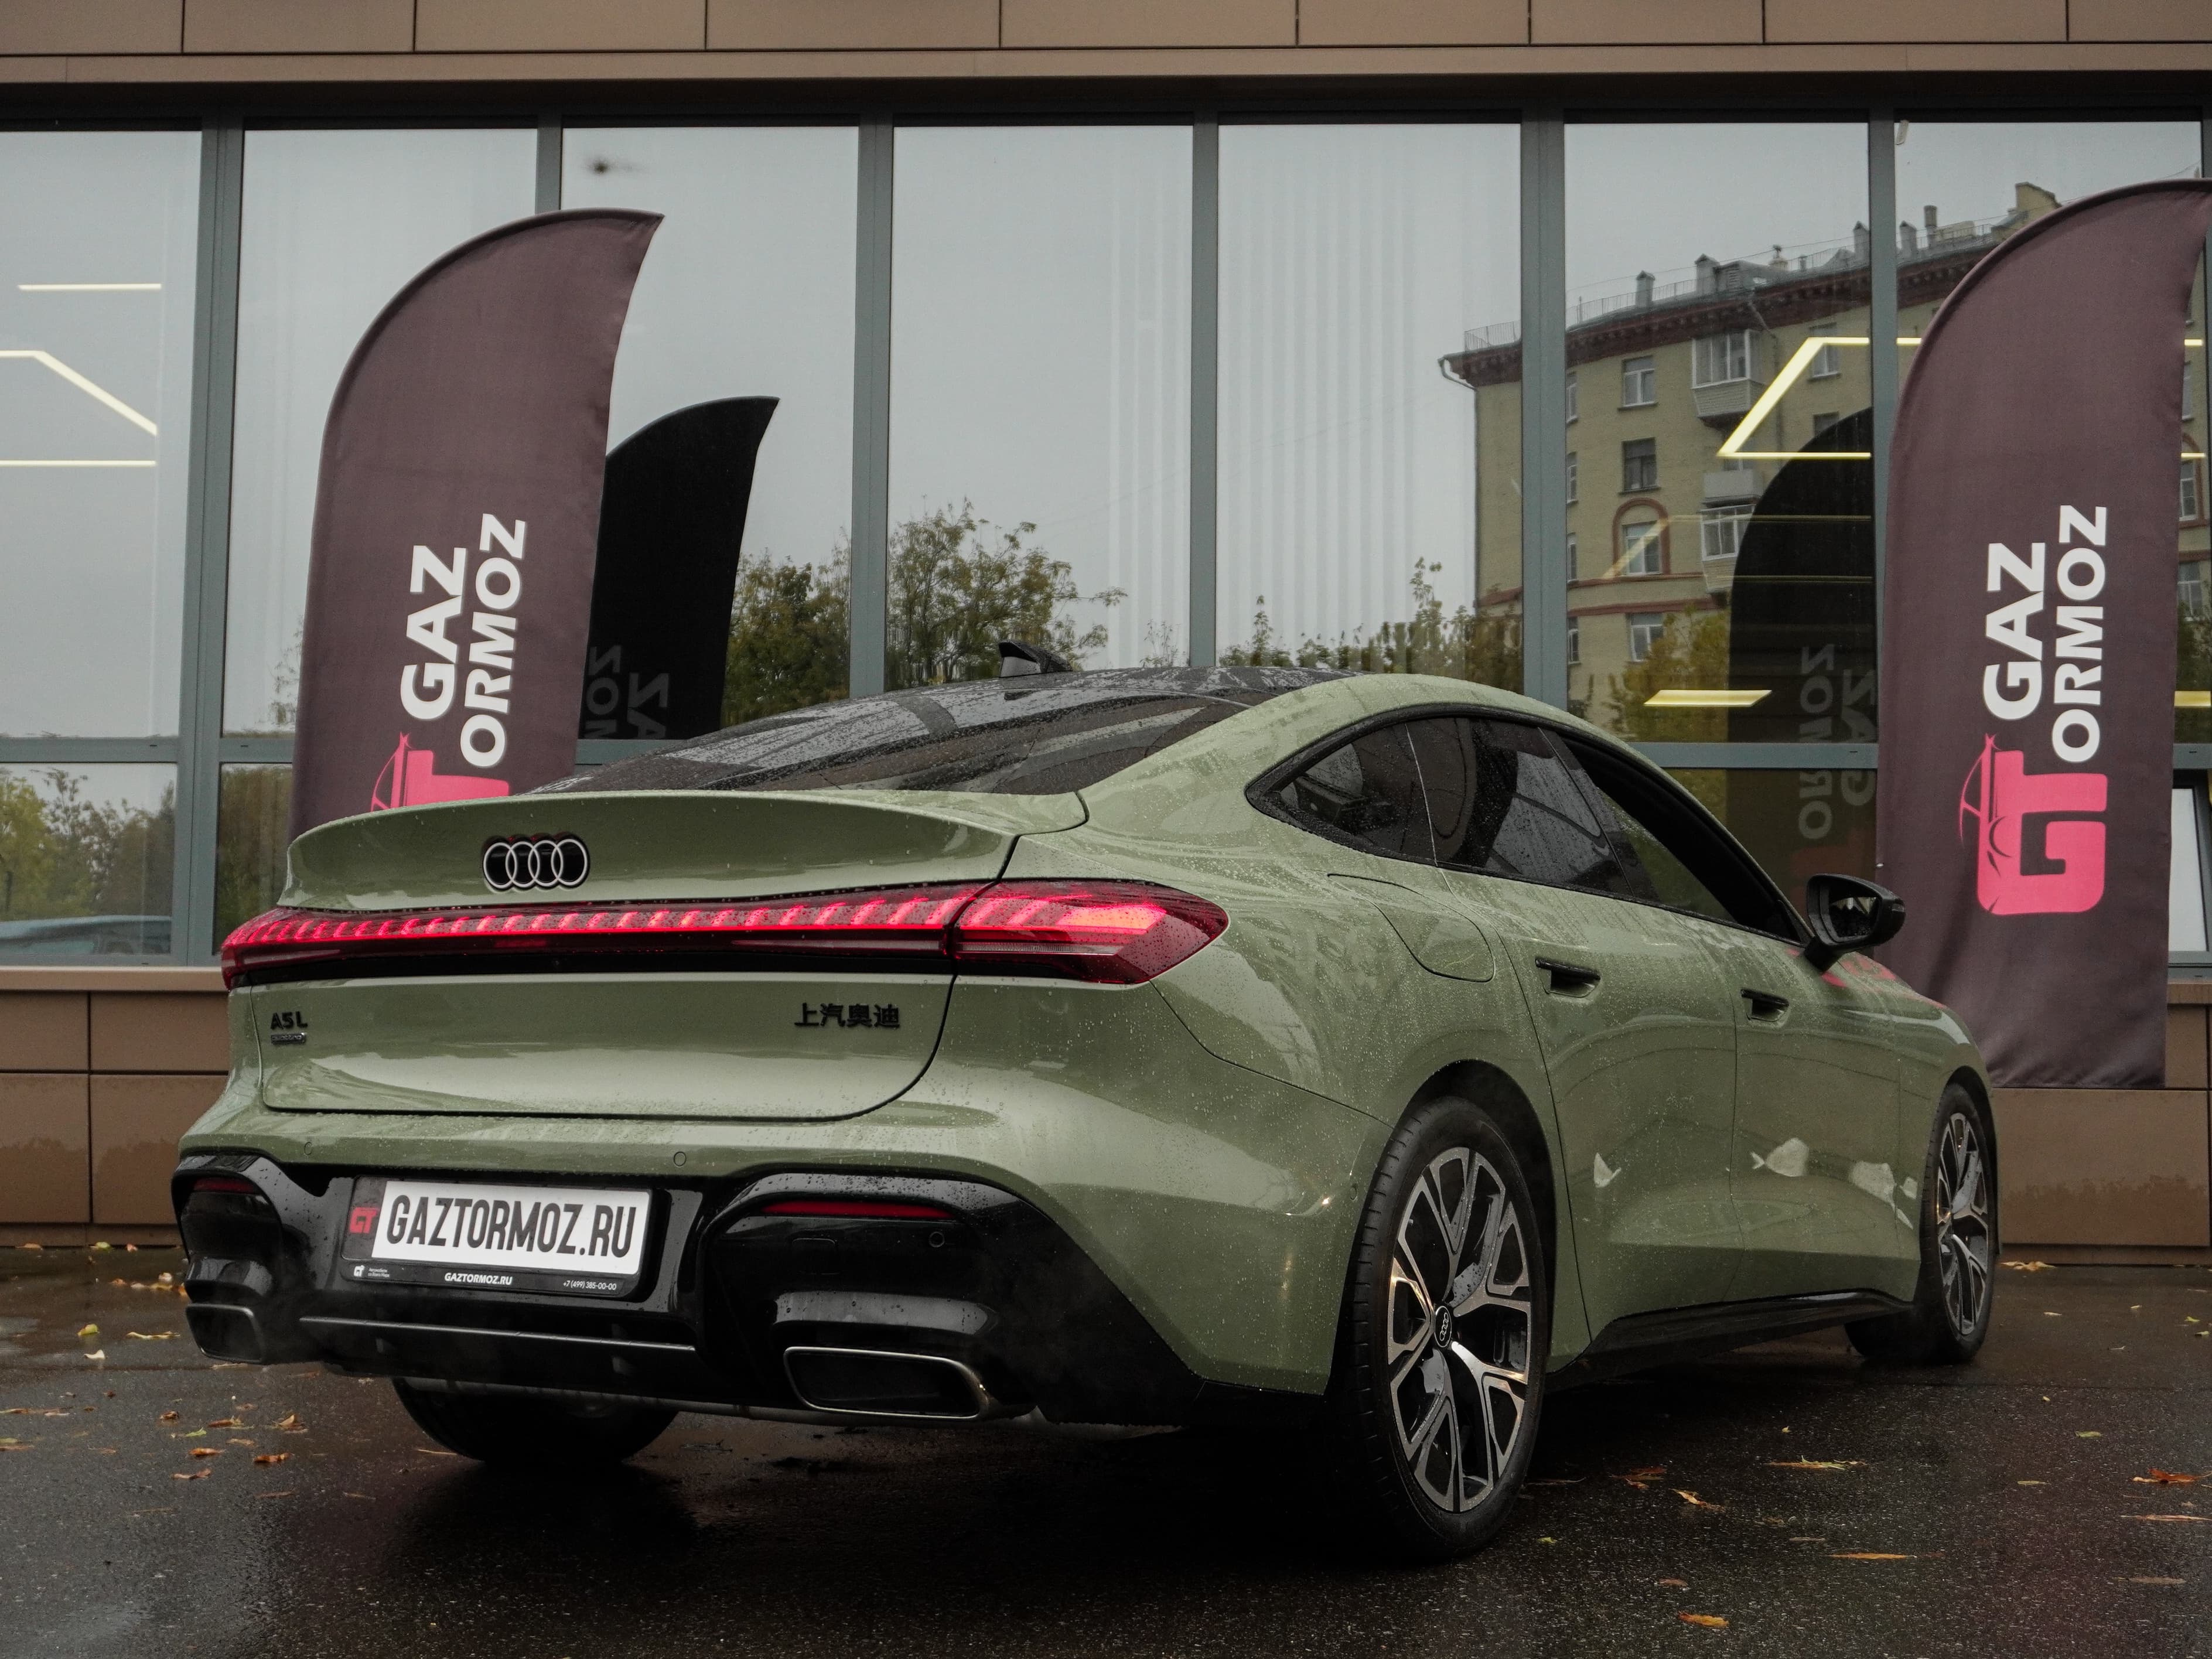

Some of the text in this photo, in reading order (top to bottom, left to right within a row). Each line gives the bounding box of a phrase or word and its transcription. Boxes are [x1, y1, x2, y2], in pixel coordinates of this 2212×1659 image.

[400, 545, 466, 719] GAZ
[460, 513, 526, 768] ORMOZ
[1983, 542, 2045, 721] GAZ
[2052, 504, 2107, 763] ORMOZ
[270, 1012, 308, 1030] A5L
[794, 1002, 900, 1028] 上汽奥迪
[387, 1194, 637, 1258] GAZTORMOZ.RU
[445, 1272, 513, 1285] GAZTORMOZ.RU
[571, 1280, 585, 1289] (499)
[586, 1281, 617, 1290] 385-00-00
